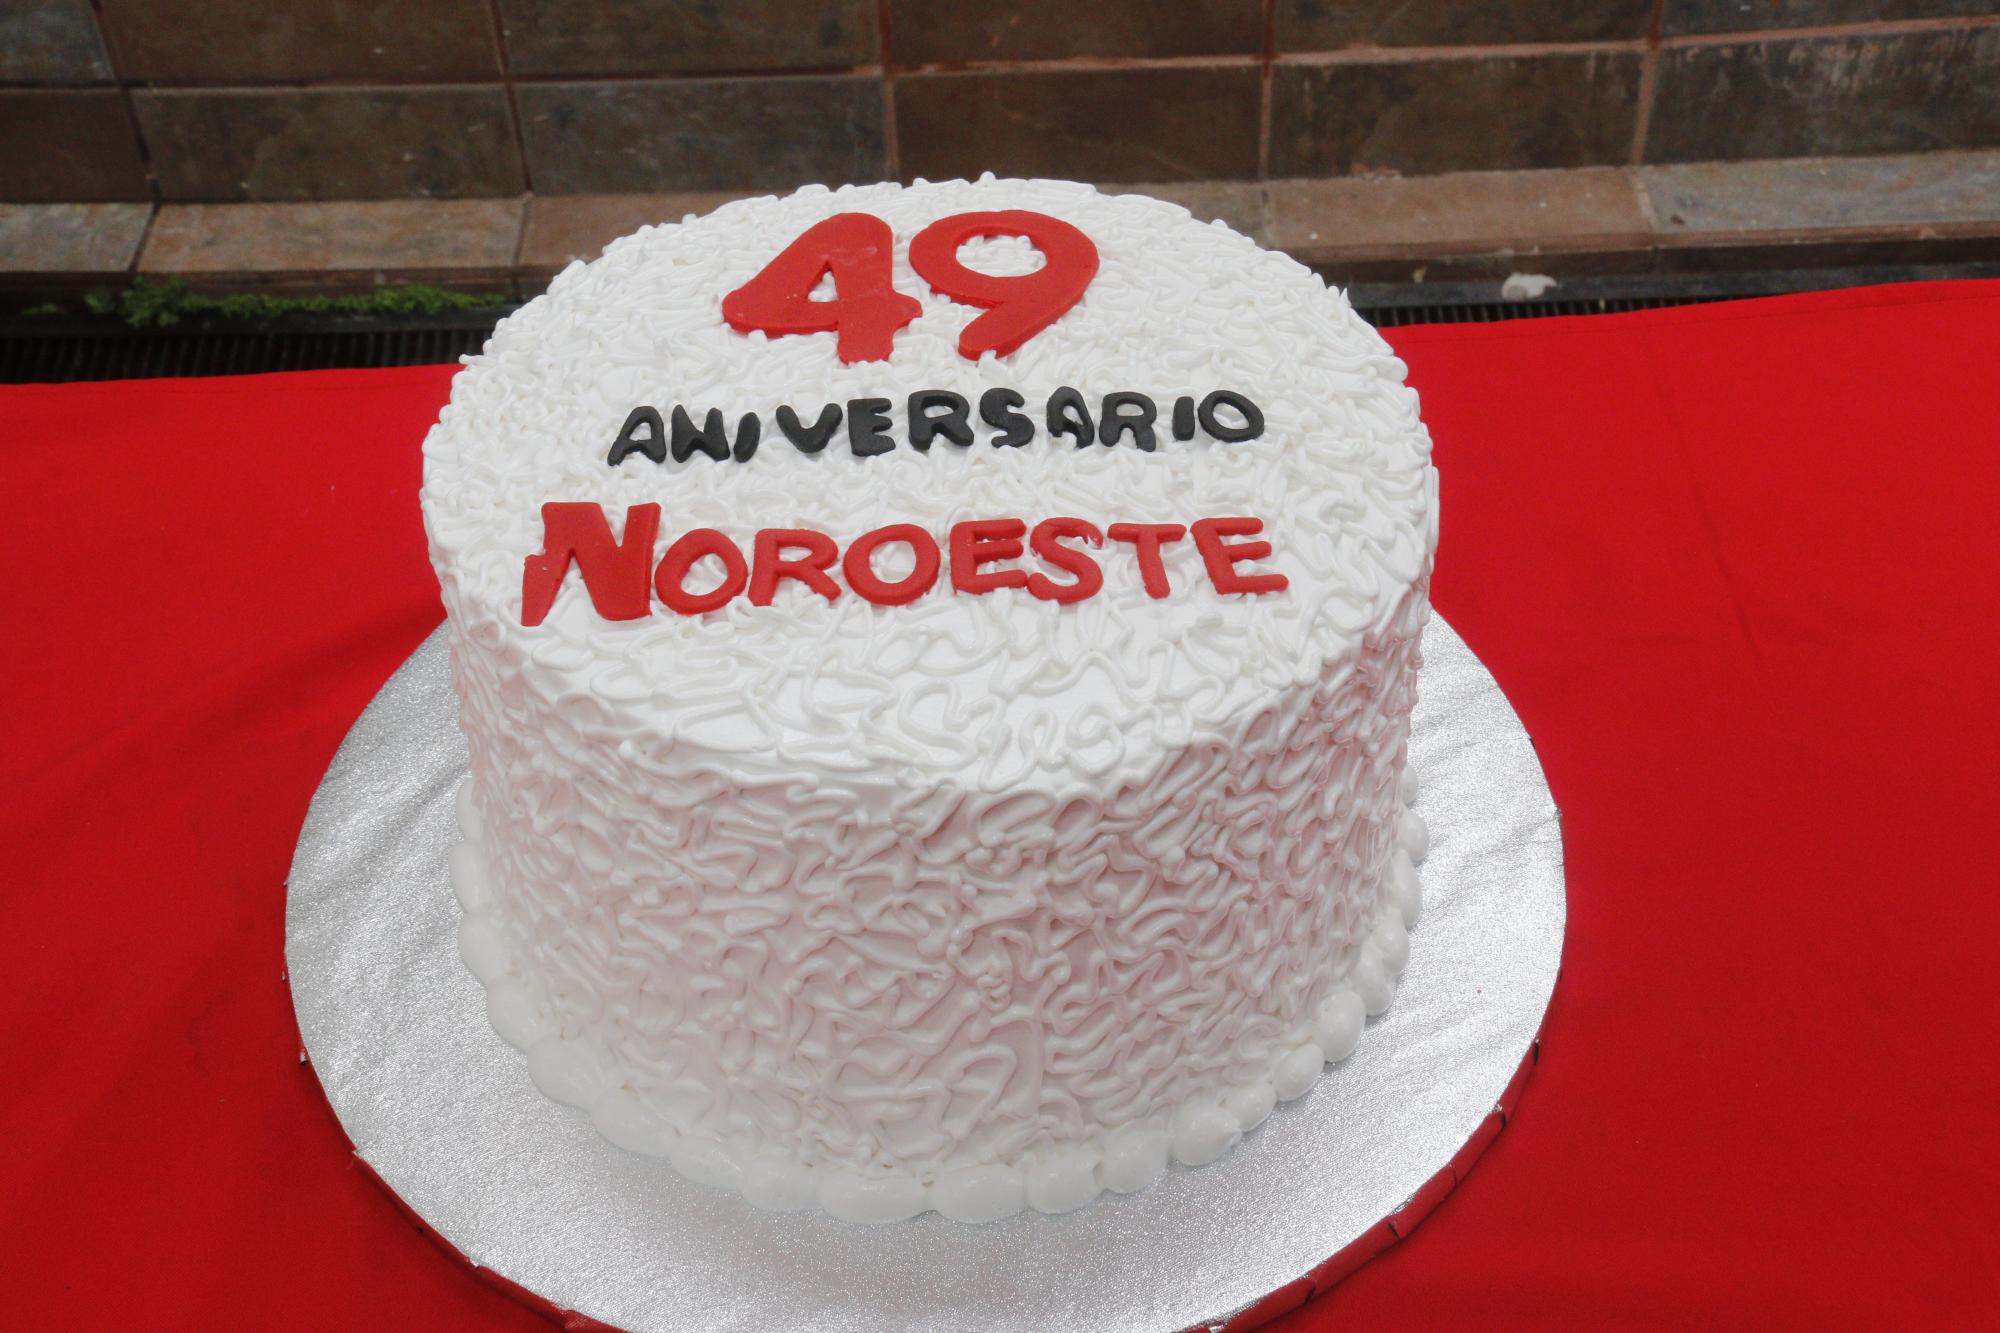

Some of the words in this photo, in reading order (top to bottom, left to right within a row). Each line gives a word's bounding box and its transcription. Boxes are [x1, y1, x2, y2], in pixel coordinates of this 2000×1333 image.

[722, 209, 1099, 364] 49
[606, 385, 1266, 468] ANIVERSARIO
[521, 501, 1290, 628] NOROESTE
